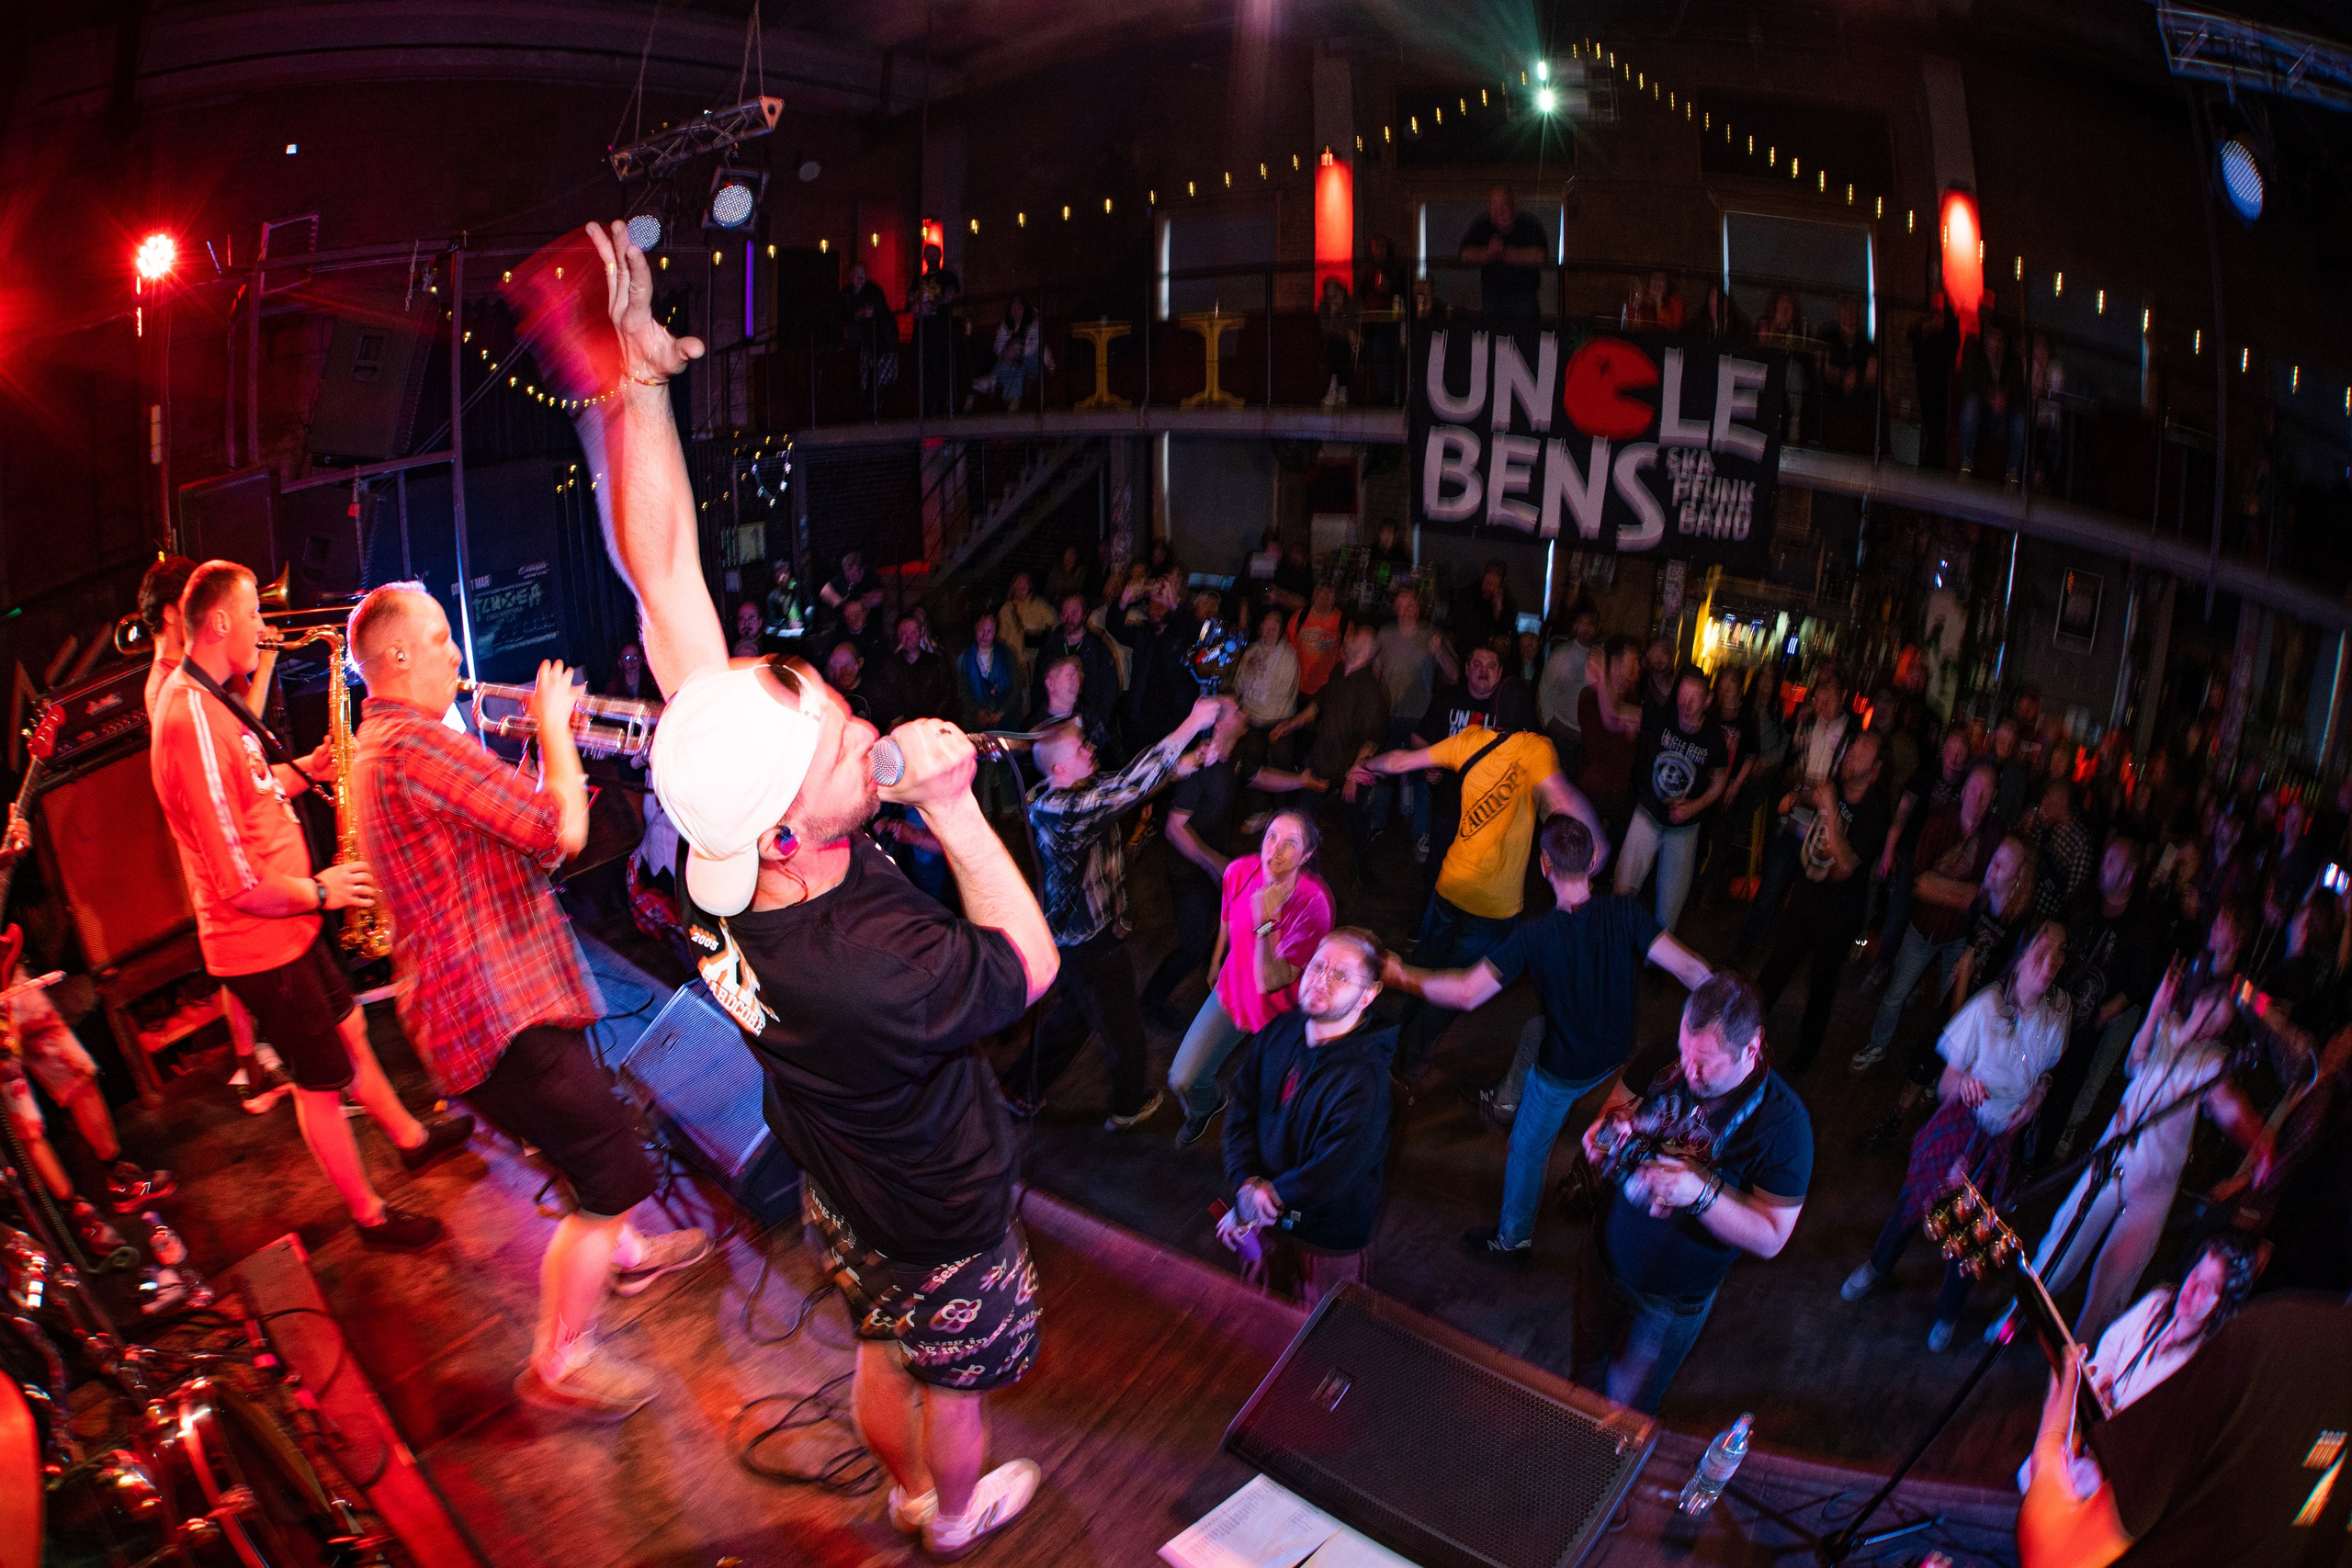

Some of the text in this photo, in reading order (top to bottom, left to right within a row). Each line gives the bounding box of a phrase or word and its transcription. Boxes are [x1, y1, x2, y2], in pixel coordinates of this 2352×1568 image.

[1666, 446, 1716, 481] SKA
[1422, 424, 1666, 551] BENS
[1671, 472, 1756, 511] PFUNK
[1679, 500, 1752, 542] BAND
[1685, 742, 1709, 760] BENS
[690, 931, 719, 952] 2005
[703, 972, 766, 1037] ARDCORE
